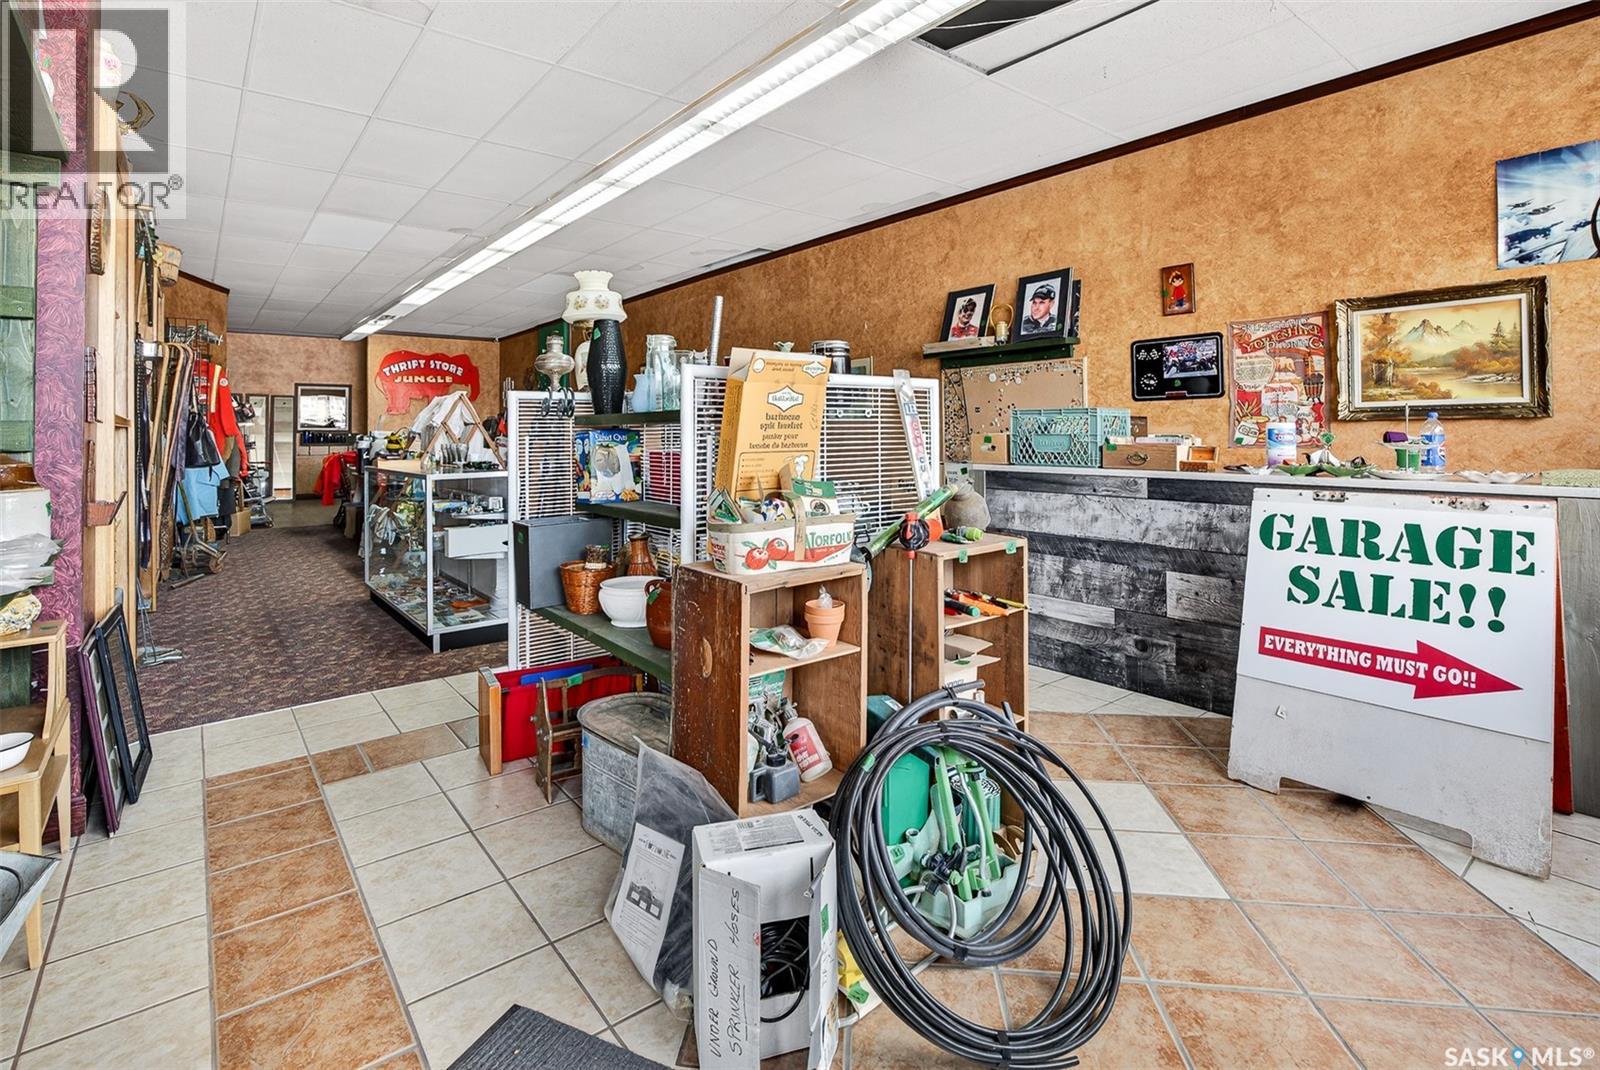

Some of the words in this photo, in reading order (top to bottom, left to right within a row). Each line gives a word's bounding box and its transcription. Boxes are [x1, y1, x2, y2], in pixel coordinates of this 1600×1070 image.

[382, 359, 426, 377] THRIFT
[429, 359, 464, 377] STORE
[394, 375, 454, 384] JUNGLE
[1259, 513, 1536, 576] GARAGE
[1287, 564, 1506, 633] SALE!!
[1264, 633, 1372, 670] EVERYTHING
[1375, 654, 1429, 680] MUST
[1432, 668, 1477, 689] GO!!
[724, 888, 741, 948] HOSES
[710, 1007, 721, 1058] UNDER
[726, 963, 744, 1057] SPRINKLER
